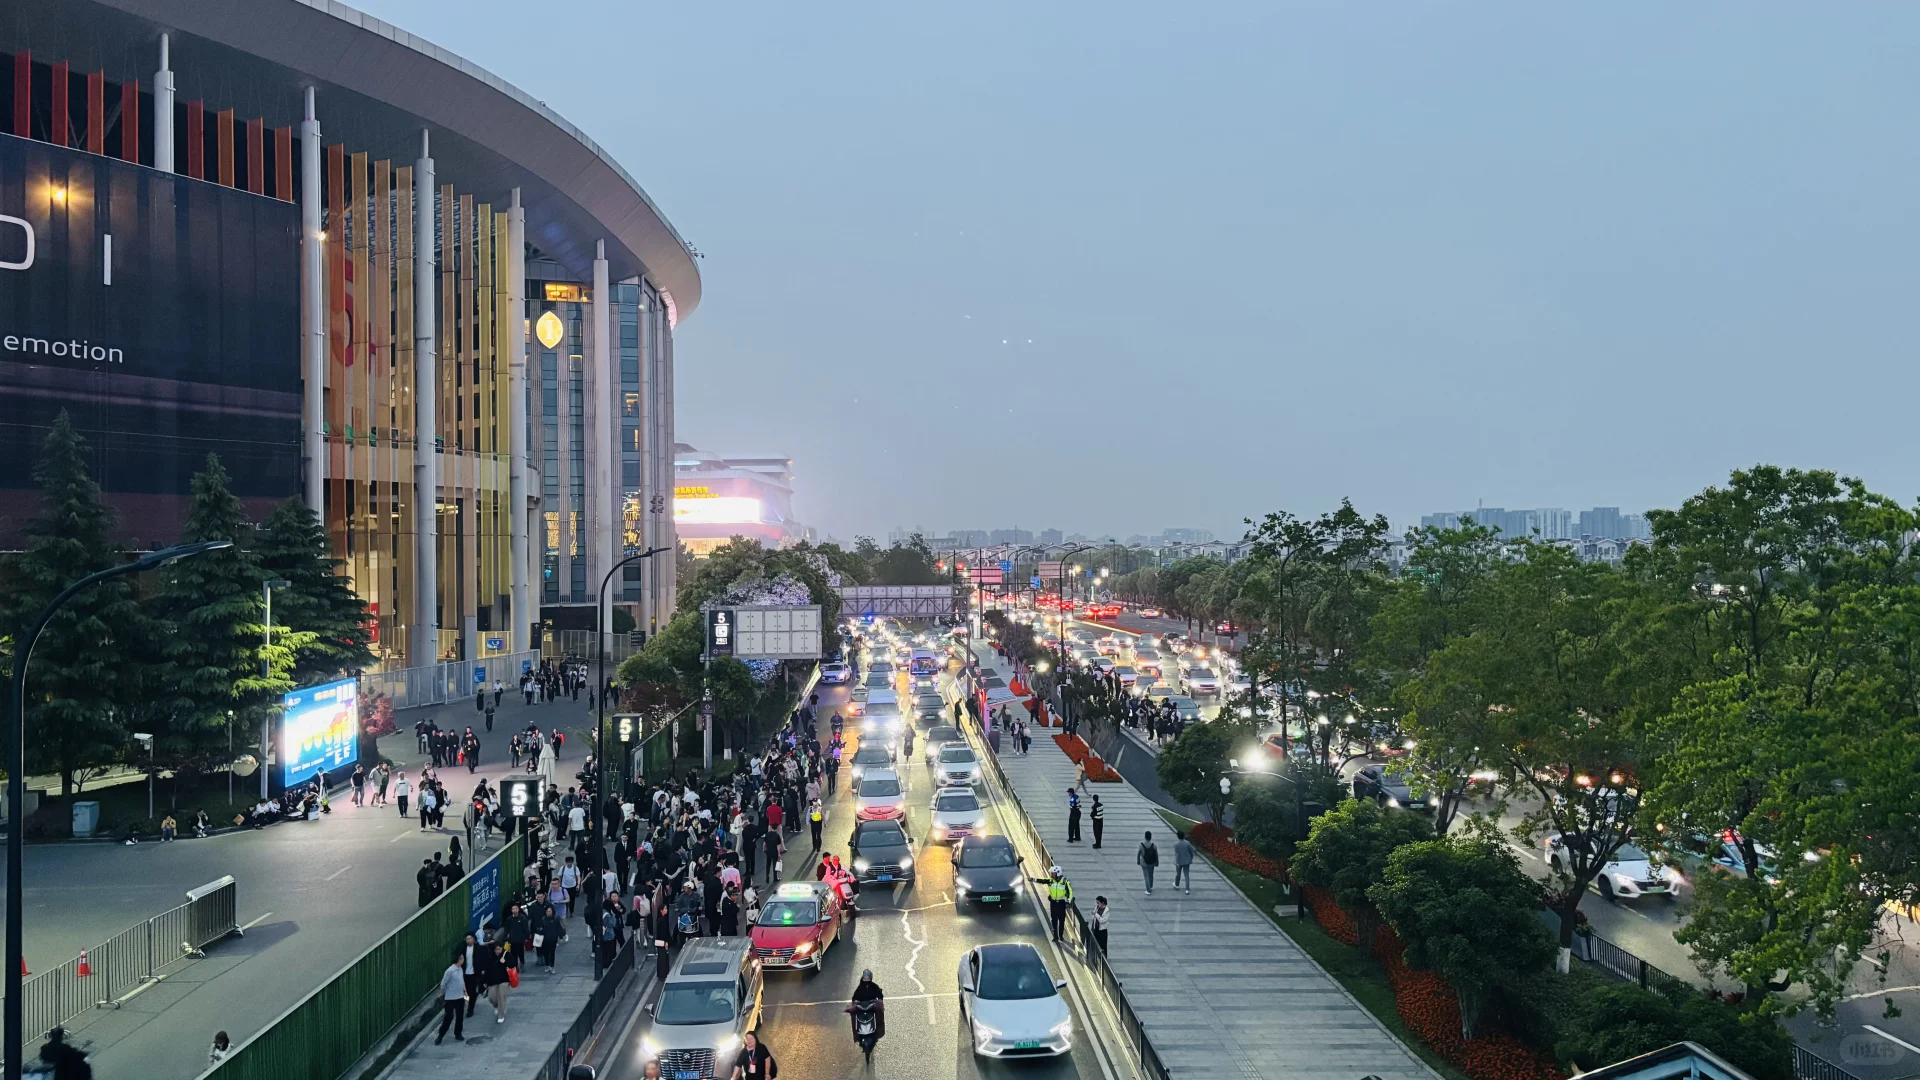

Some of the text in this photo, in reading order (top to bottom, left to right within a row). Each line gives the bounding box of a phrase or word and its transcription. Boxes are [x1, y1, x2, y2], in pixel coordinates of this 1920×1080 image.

[3, 335, 124, 364] emotion
[717, 612, 726, 624] 5
[704, 688, 711, 696] 5
[619, 718, 633, 735] 5
[510, 782, 528, 806] 5
